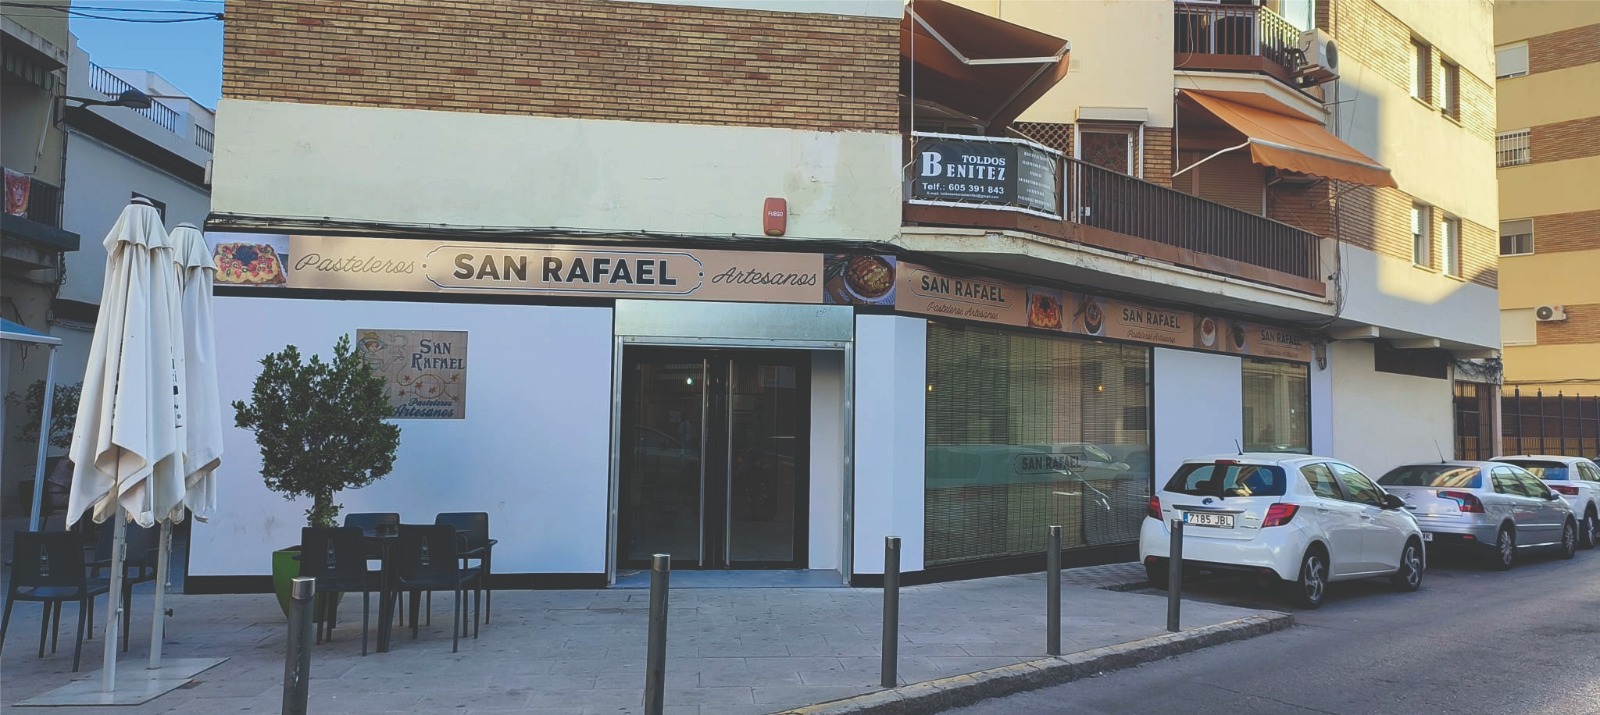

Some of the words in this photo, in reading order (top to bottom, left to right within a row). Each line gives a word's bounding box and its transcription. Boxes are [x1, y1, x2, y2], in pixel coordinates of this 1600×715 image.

[921, 151, 1006, 181] BENITEZ
[962, 154, 1006, 166] TOLDOS
[922, 182, 946, 191] Telf.:
[948, 183, 966, 192] 605
[968, 184, 984, 194] 391
[987, 186, 1005, 195] 843
[294, 253, 415, 275] Pasteleros
[452, 253, 528, 282] SAN
[541, 256, 678, 287] RAFAEL
[711, 265, 819, 288] Artesanos
[920, 274, 950, 295] SAN
[955, 280, 1006, 303] RAFAEL
[926, 301, 964, 316] Pasteleros
[964, 306, 999, 320] Artesanos
[1122, 307, 1143, 323] SAN
[1146, 311, 1180, 329] RAFAEL
[1260, 329, 1276, 341] SAN
[420, 339, 452, 355] SAN
[411, 353, 465, 371] RAFAEL
[408, 397, 453, 407] Pasteleros
[393, 403, 455, 418] Artesanos
[1021, 456, 1043, 470] SAN
[1045, 455, 1082, 470] RAFAEL
[1188, 513, 1212, 524] 7185
[1214, 515, 1232, 526] JBL
